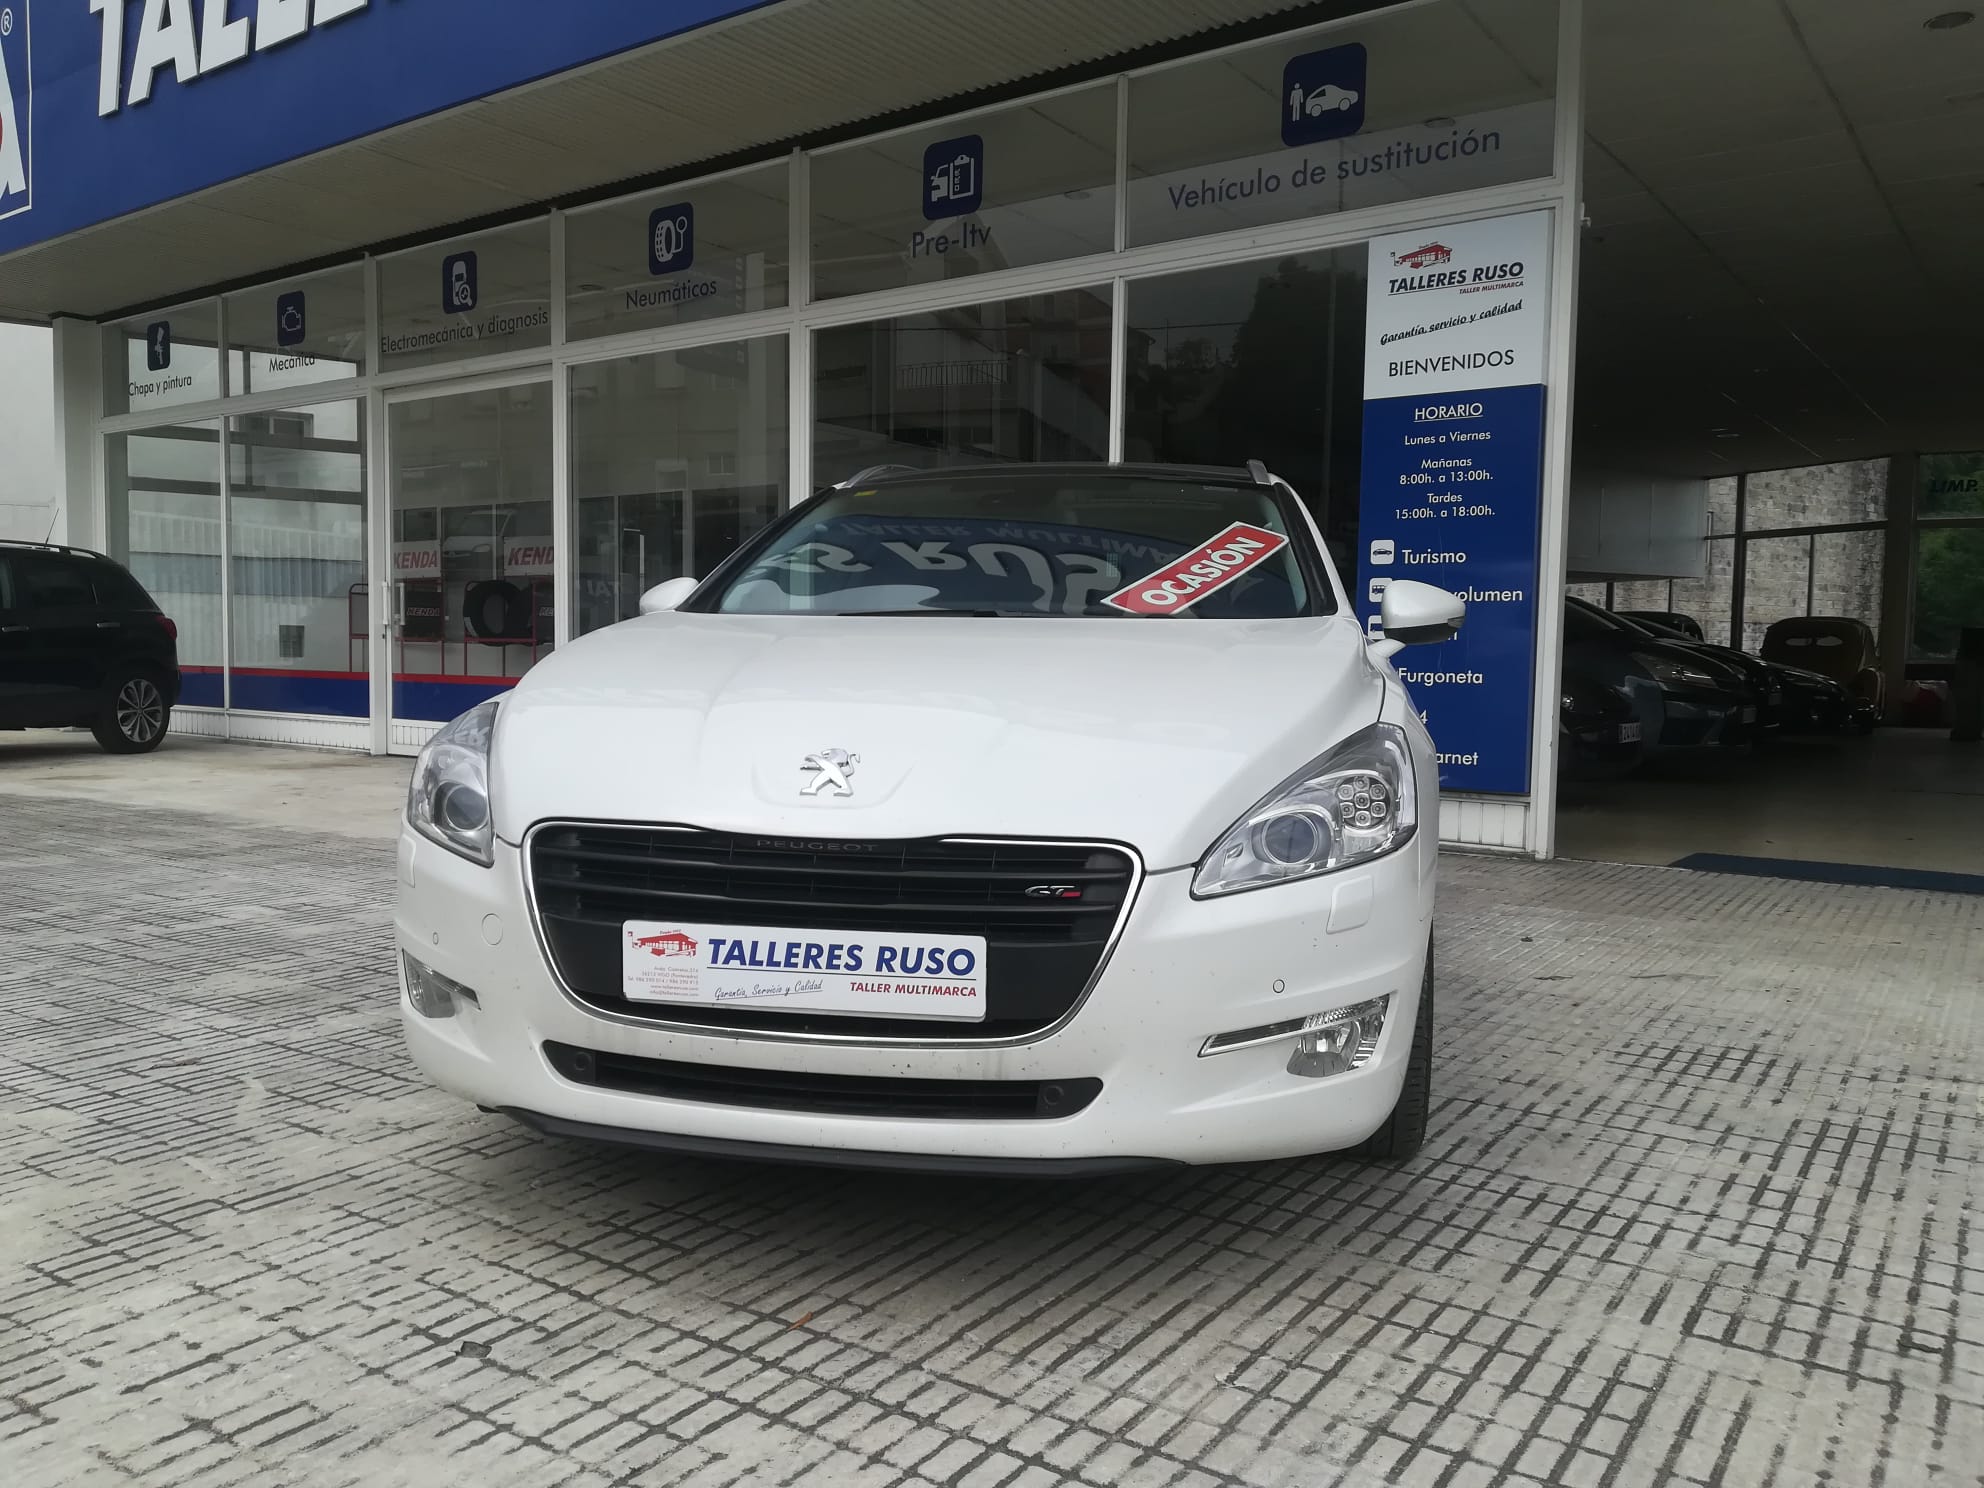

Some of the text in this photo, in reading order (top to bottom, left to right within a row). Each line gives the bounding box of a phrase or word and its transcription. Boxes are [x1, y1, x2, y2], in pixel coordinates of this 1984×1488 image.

[1168, 129, 1500, 211] Vehículo de sustitución
[911, 222, 992, 259] Pre-Itv
[1389, 261, 1524, 293] TALLERES RUSO
[625, 277, 717, 310] Neumáticos
[1459, 281, 1524, 295] TALLER MULTIMARCA
[1429, 314, 1467, 333] servicio
[1469, 312, 1477, 324] y
[1479, 299, 1523, 320] calidad
[381, 306, 548, 353] Electromecánica y diagnosis
[268, 353, 315, 373] Mecánica
[1388, 349, 1514, 377] BIENVENIDOS
[128, 375, 192, 397] Chapa y pintura
[1415, 402, 1483, 421] HORARIO
[1404, 431, 1491, 446] Lunes a Viernes
[1421, 458, 1473, 469] Mañanas
[1399, 469, 1494, 485] 8:00h. a 13:00h.
[1427, 491, 1463, 504] Tardes
[1395, 507, 1437, 520] 15:00h.
[1451, 505, 1496, 517] 18:00h.
[394, 551, 438, 570] KENDA
[508, 546, 554, 567] KEND
[1402, 549, 1467, 565] Turismo
[1141, 536, 1266, 606] OCASIÓN
[1398, 667, 1483, 687] Furgoneta
[1436, 752, 1479, 766] arnet
[756, 839, 880, 851] PEUGEOT
[707, 937, 976, 977] TALLERES RUSO
[751, 983, 782, 996] Servicio
[784, 986, 791, 997] y
[794, 979, 823, 991] Calidad
[850, 982, 891, 993] TALLER
[894, 983, 977, 997] MULTIMARCA
